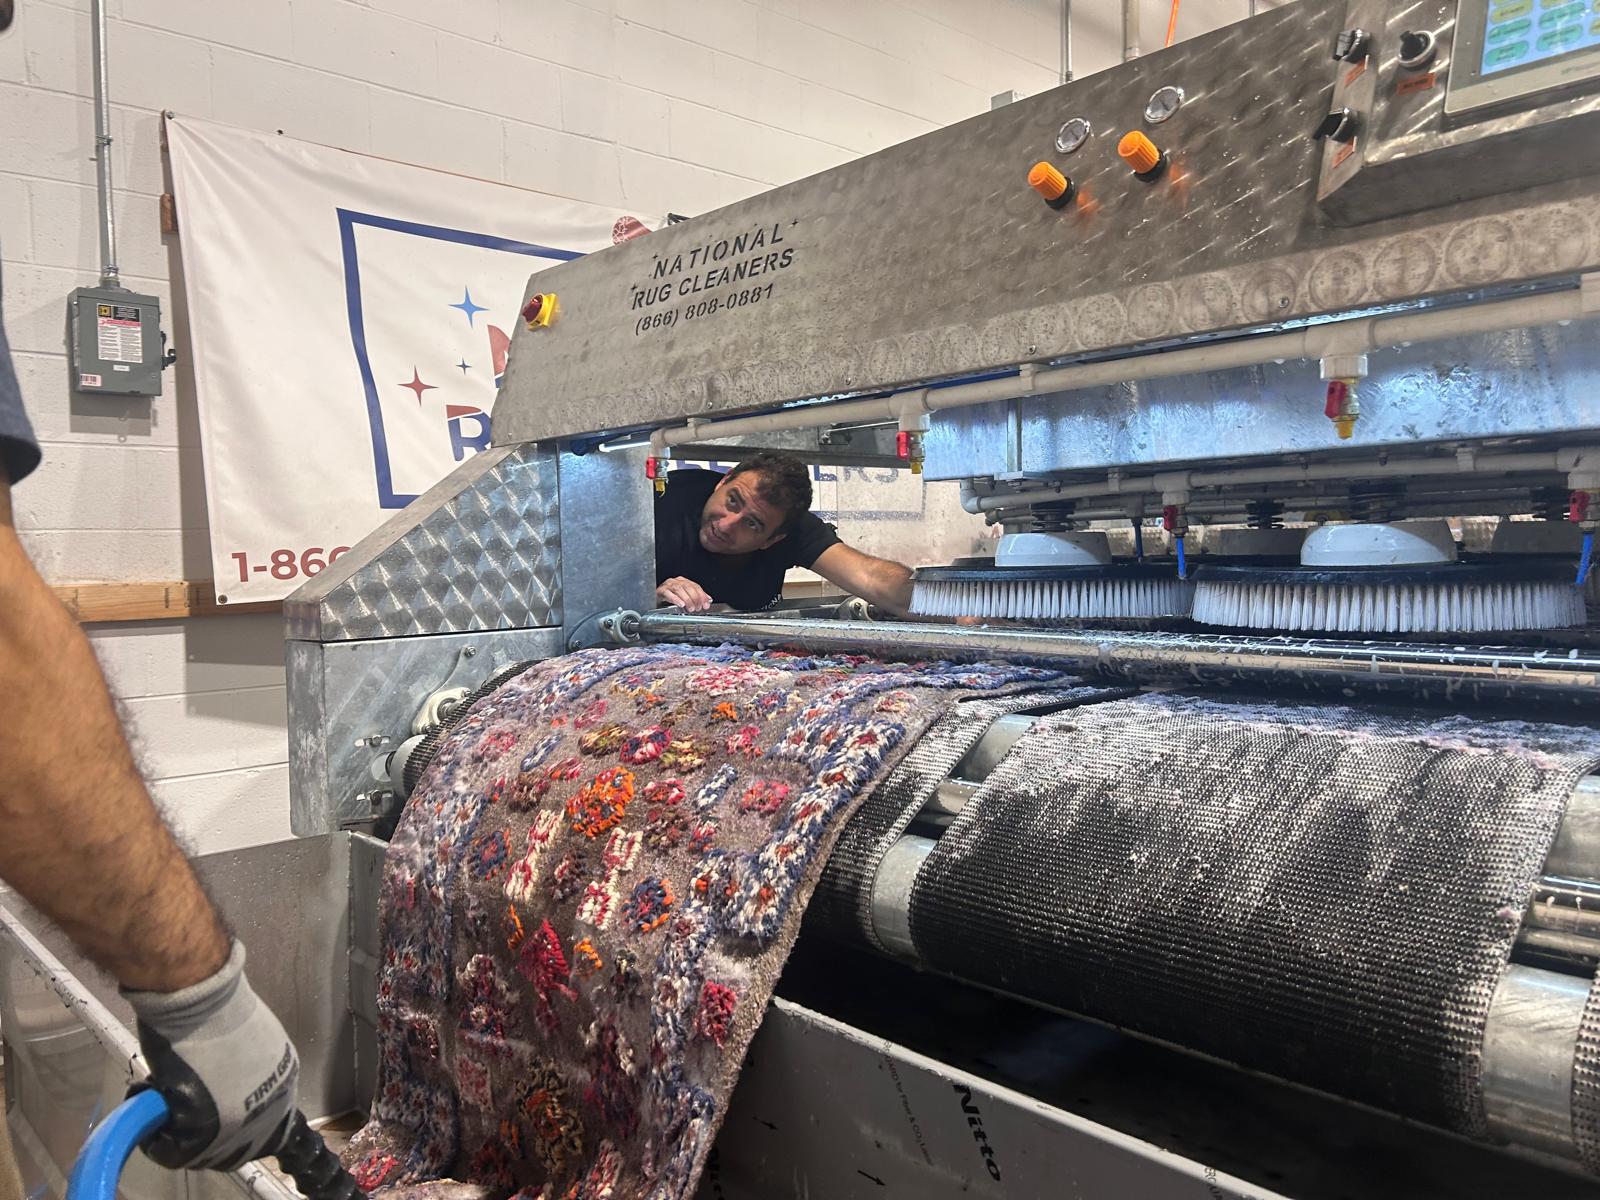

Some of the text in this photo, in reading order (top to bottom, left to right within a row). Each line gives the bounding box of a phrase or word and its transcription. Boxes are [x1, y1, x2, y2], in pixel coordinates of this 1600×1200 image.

[631, 248, 795, 310] RUG CLEANERS
[653, 223, 784, 280] NATIONAL
[635, 283, 774, 336] (866) 808-0881
[244, 1071, 278, 1112] FIRM
[951, 1084, 1001, 1182] Nitto
